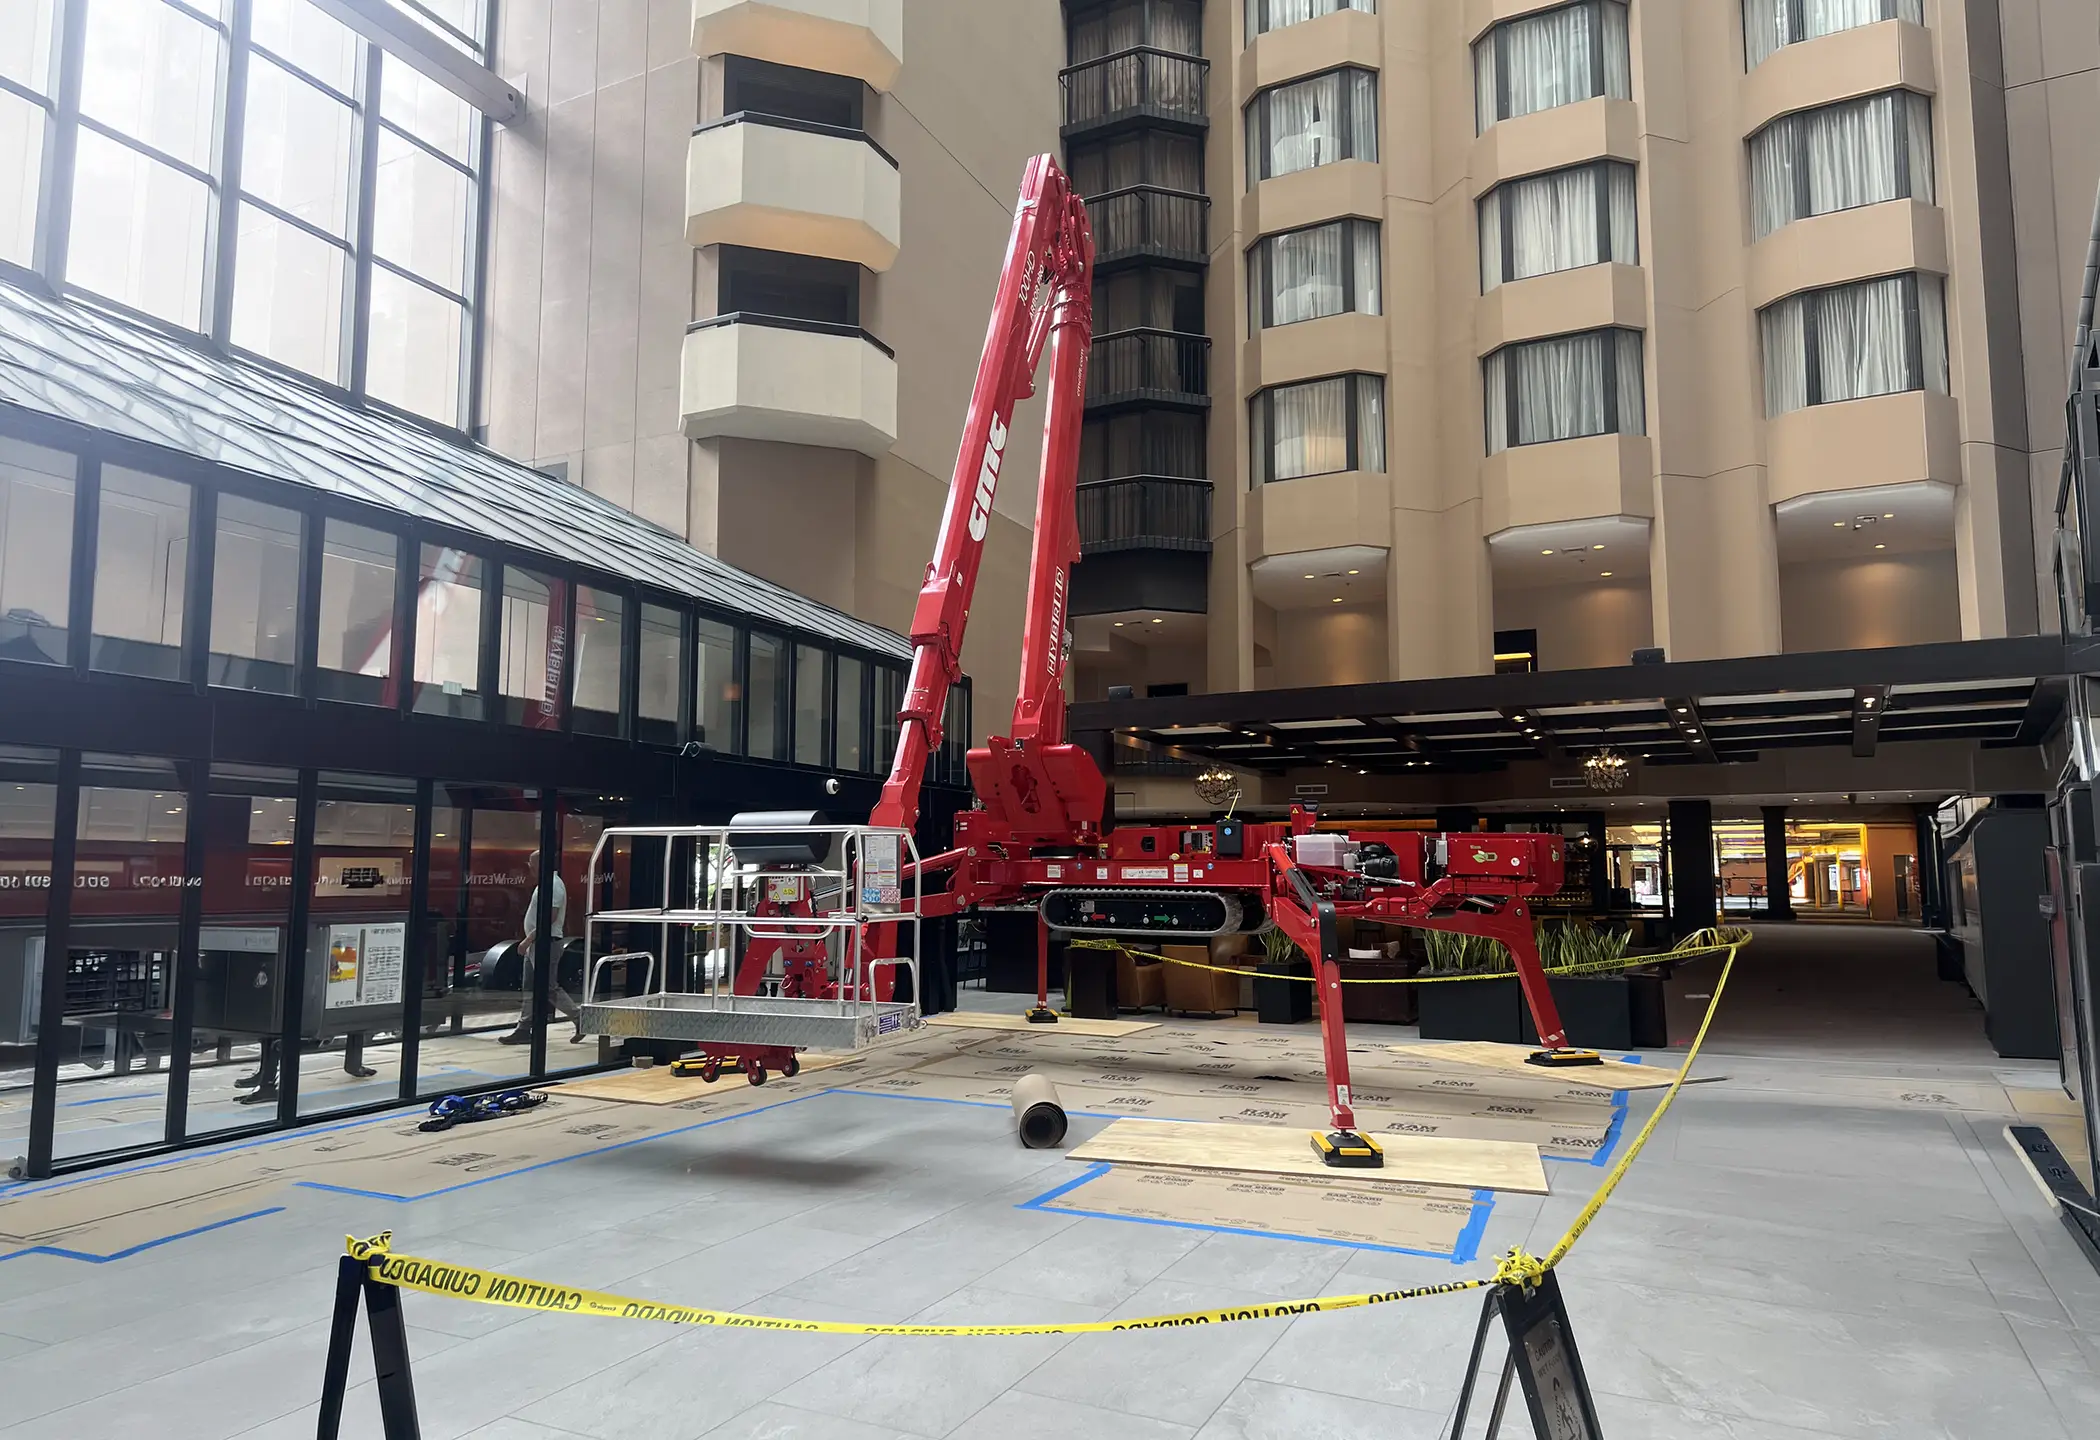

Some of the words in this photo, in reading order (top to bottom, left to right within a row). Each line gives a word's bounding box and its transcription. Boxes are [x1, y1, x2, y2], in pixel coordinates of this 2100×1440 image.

[968, 410, 1007, 542] cmc
[1047, 566, 1064, 676] HYBRID
[1566, 964, 1595, 975] CAUTION
[1597, 960, 1625, 971] CUIDADO
